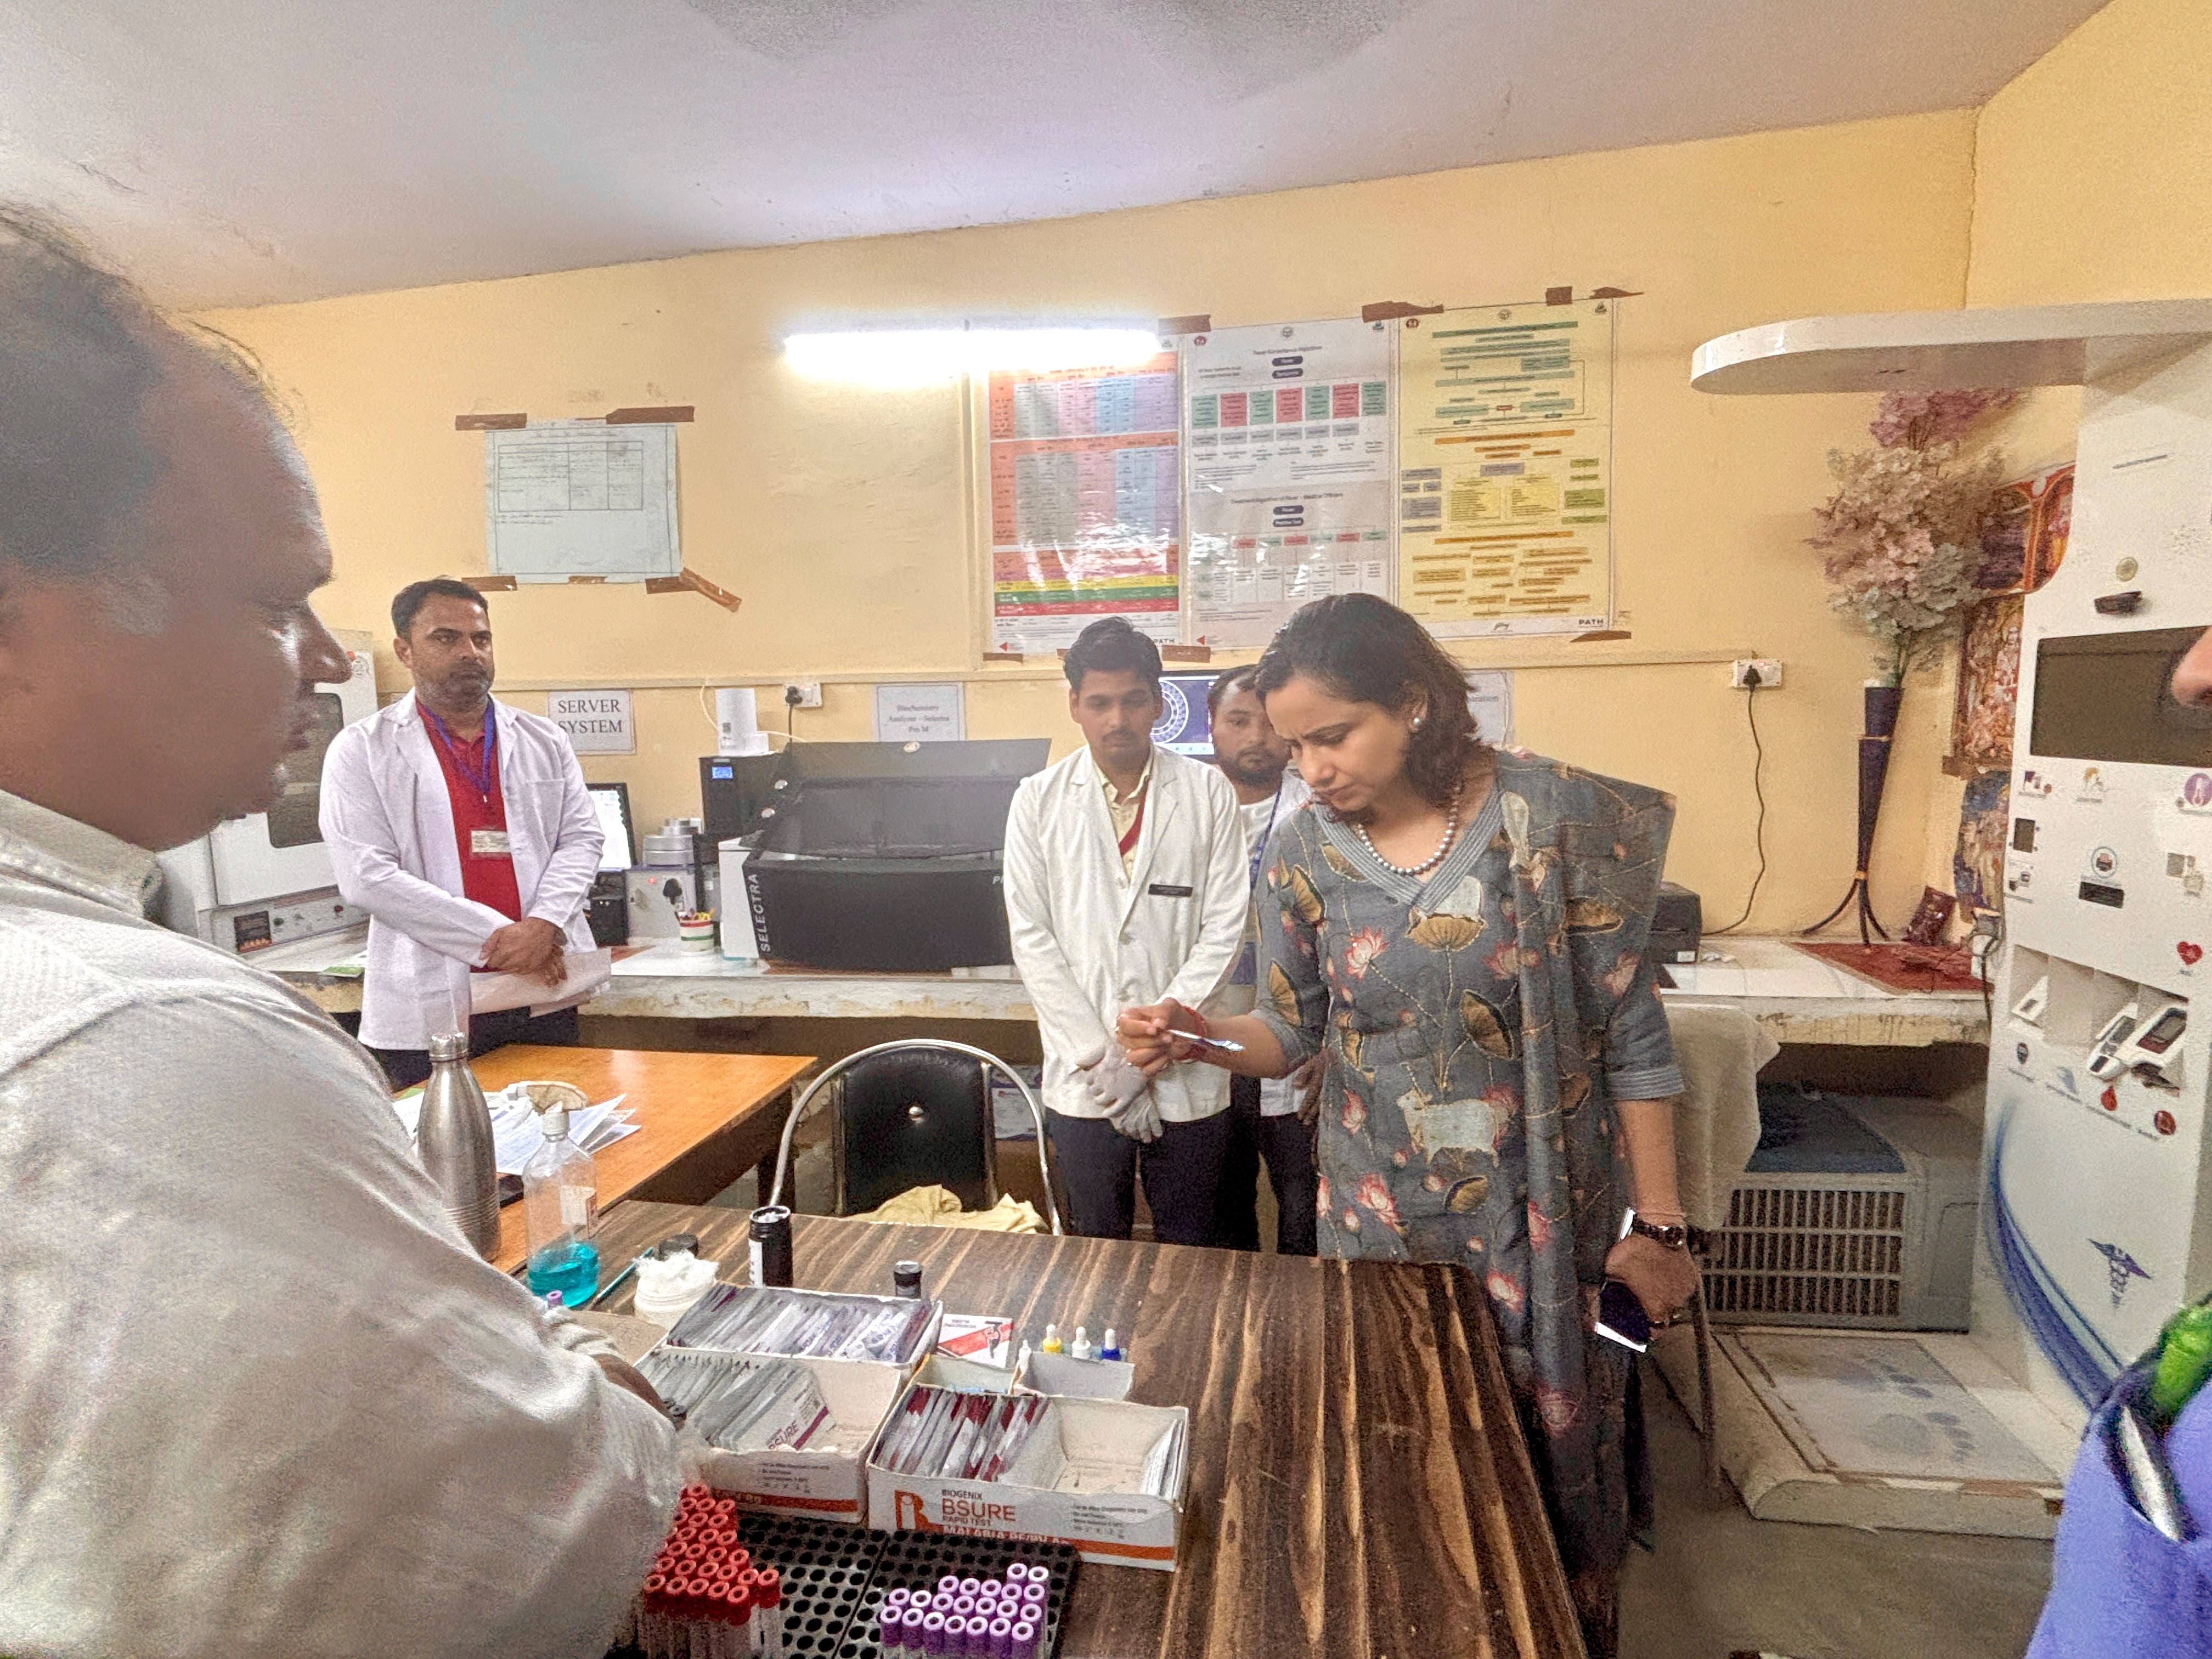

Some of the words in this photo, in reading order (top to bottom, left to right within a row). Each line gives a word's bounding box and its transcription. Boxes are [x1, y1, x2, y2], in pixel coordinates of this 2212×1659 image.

[558, 699, 621, 713] SERVER
[558, 719, 622, 733] SYSTEM
[747, 873, 771, 952] SELECTRA
[941, 1489, 983, 1500] BIOGENIX
[943, 1498, 1017, 1522] BSURE
[943, 1515, 969, 1525] RAPID
[971, 1519, 991, 1527] TEST
